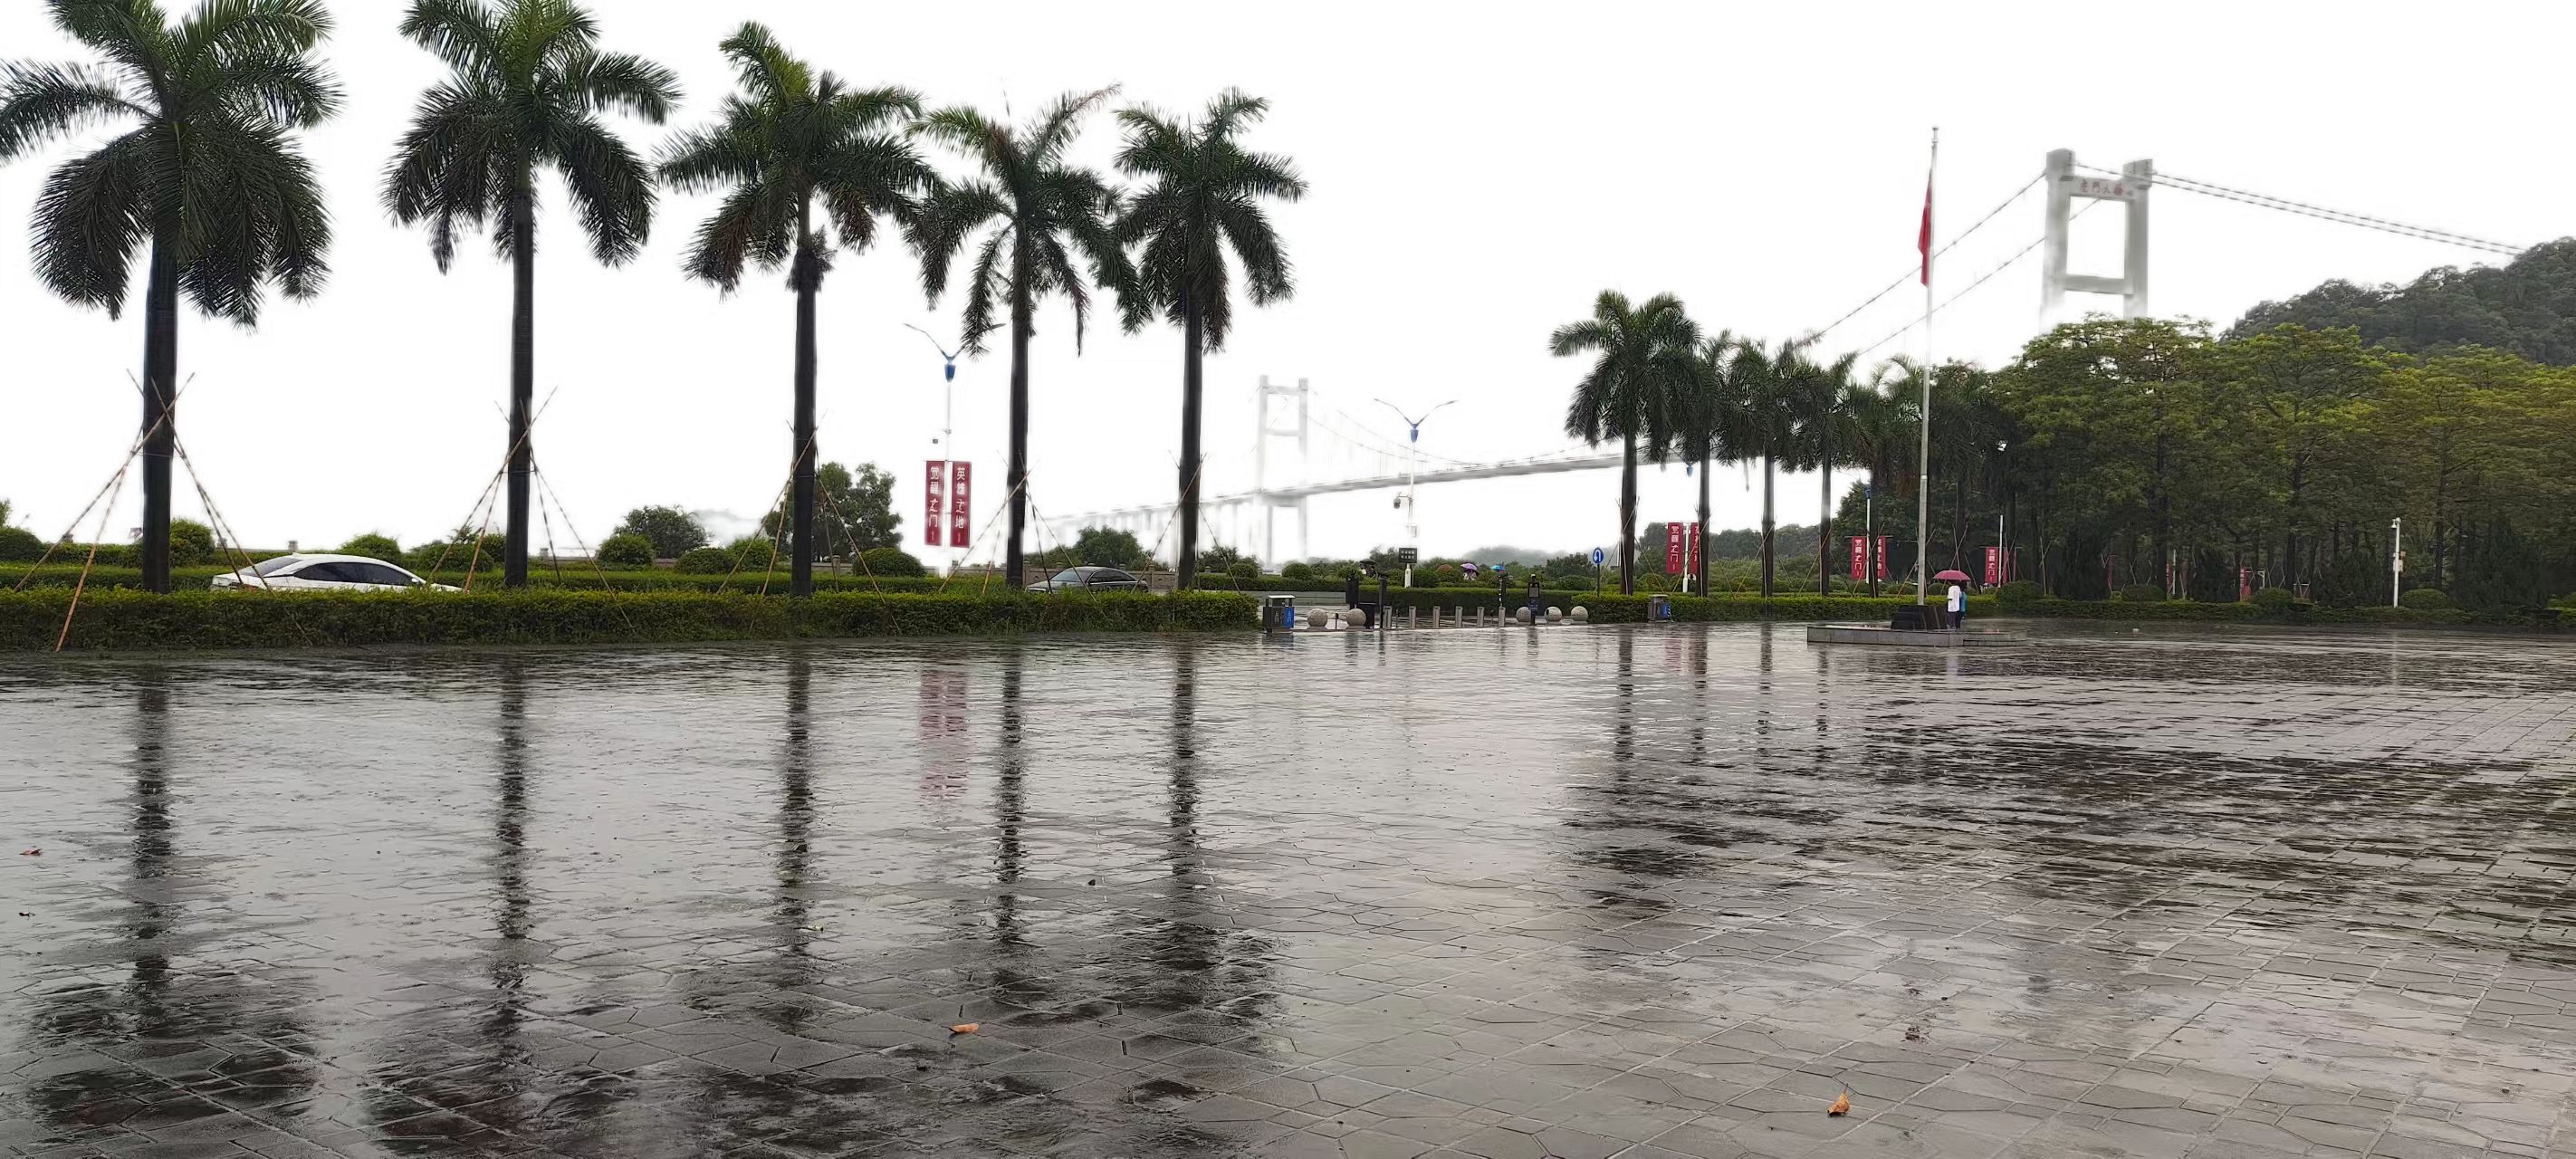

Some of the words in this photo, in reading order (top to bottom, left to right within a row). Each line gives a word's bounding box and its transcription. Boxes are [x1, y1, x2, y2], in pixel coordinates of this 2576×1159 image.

[929, 466, 939, 528] 觉醒之门
[955, 466, 965, 529] 英雄之地
